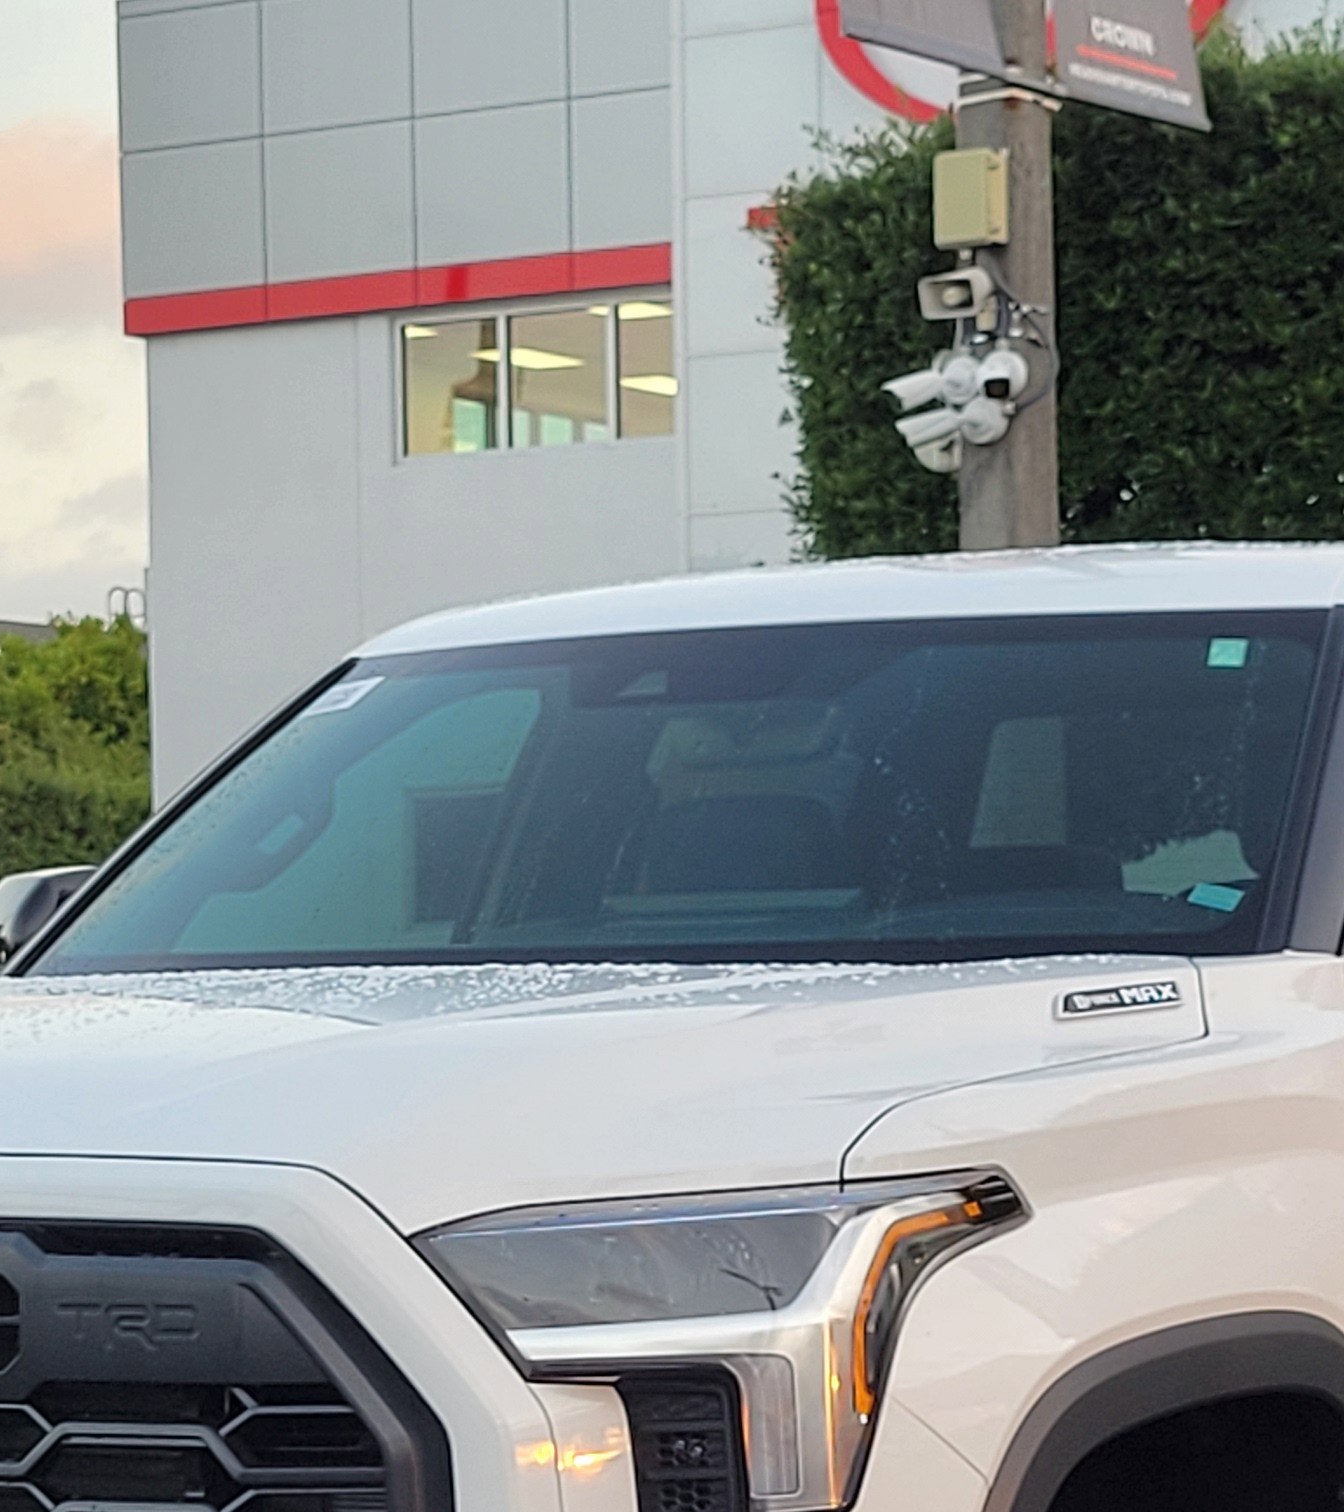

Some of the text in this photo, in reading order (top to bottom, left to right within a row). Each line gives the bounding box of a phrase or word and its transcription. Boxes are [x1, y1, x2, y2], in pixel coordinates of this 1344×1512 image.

[1090, 16, 1155, 56] CROWN
[1119, 984, 1177, 1004] MAX
[56, 1302, 201, 1351] TRD
